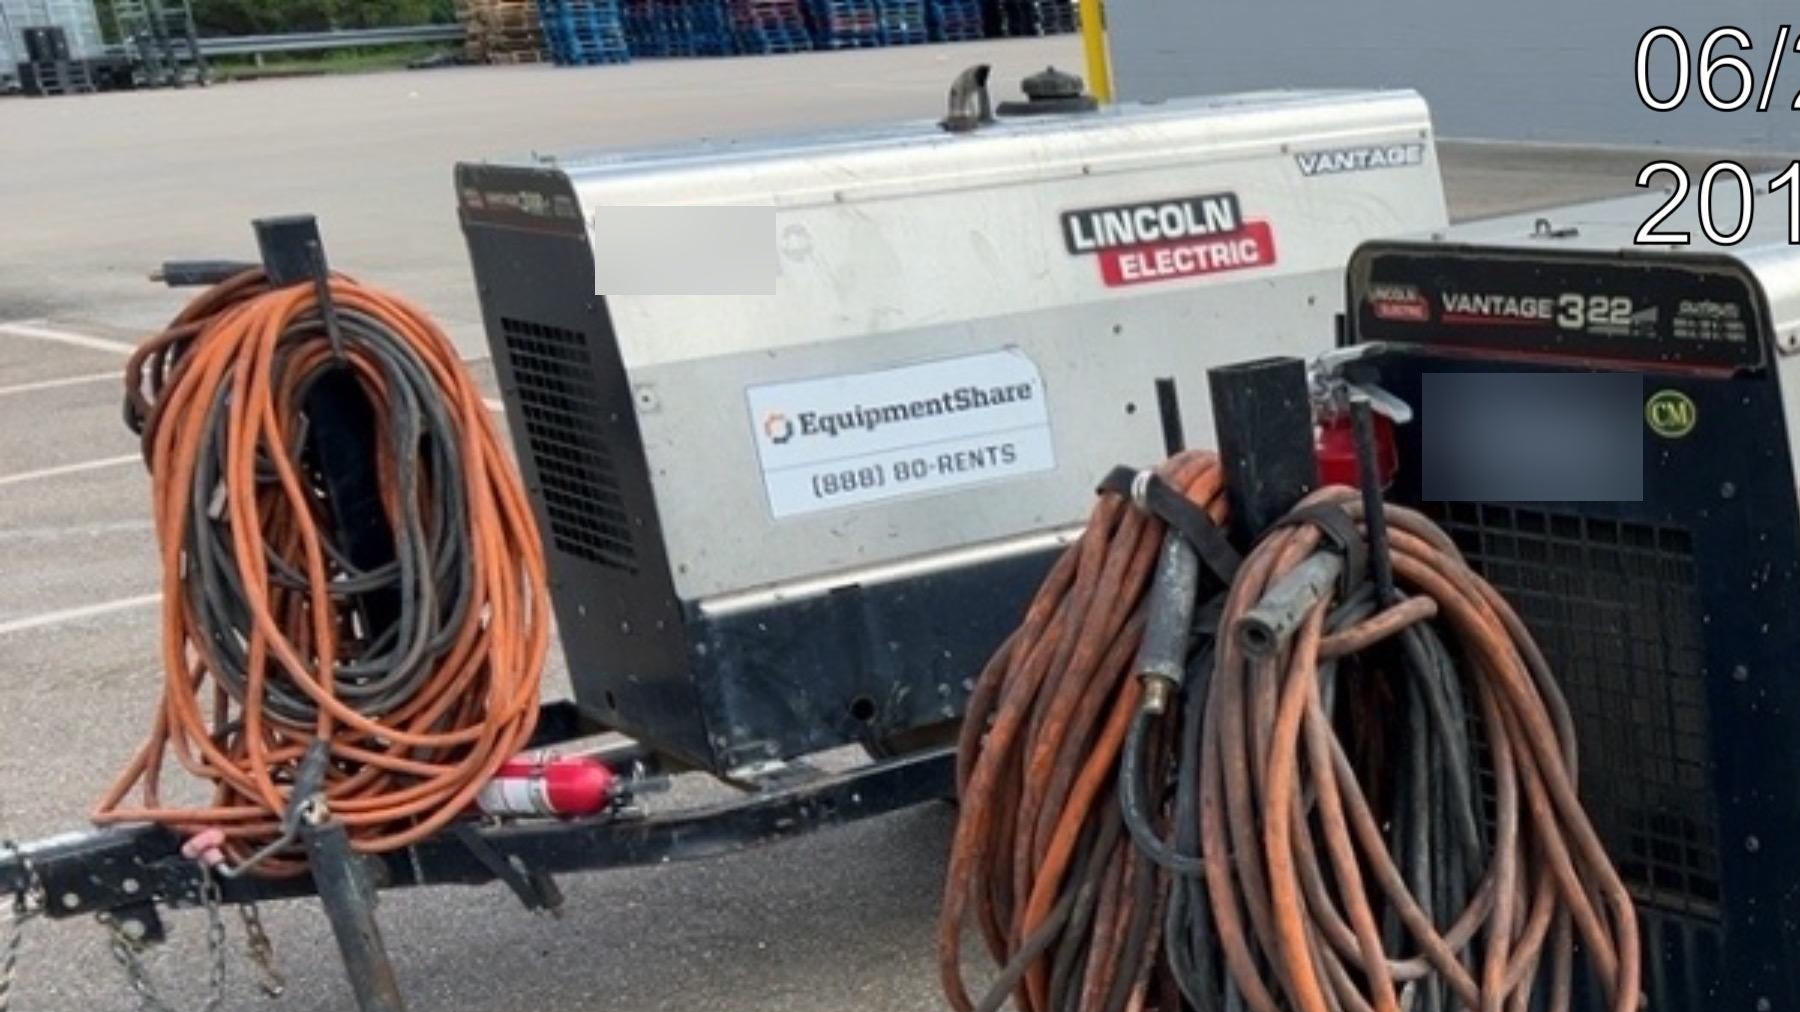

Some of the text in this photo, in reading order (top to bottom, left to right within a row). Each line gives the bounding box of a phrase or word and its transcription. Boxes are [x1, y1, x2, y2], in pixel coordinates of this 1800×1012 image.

[1294, 143, 1423, 175] VANTAGE
[1068, 197, 1235, 250] LINCOLN
[1118, 238, 1260, 281] ELECTRIC
[1442, 291, 1553, 319] VANTAGE
[1556, 293, 1633, 328] 322
[798, 381, 1033, 438] EquipmentShare
[812, 443, 1018, 499] (888) 80-RENTS
